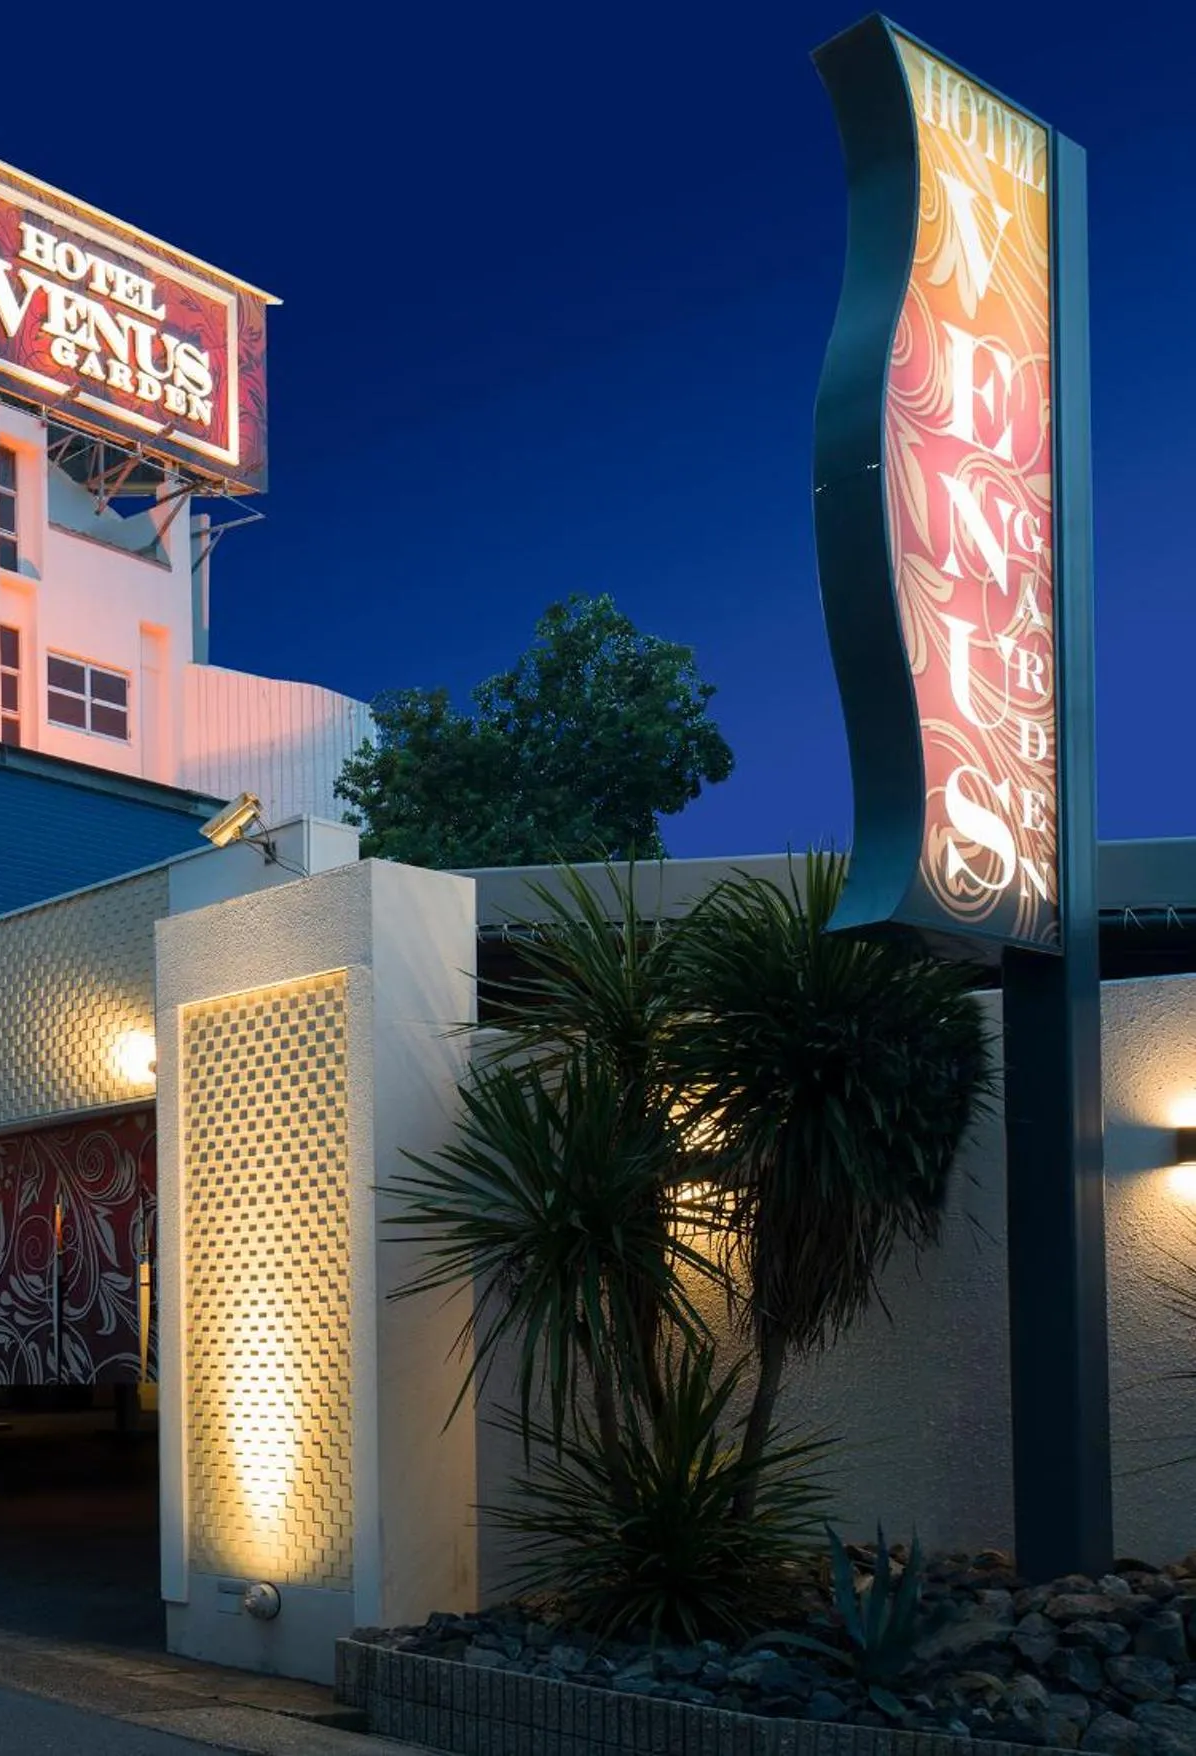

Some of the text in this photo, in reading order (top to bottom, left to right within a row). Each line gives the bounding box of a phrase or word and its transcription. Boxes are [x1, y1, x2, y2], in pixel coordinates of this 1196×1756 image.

[923, 56, 1046, 193] HOTEL
[19, 221, 165, 321] HOTEL
[51, 337, 212, 426] GARDEN
[936, 168, 1015, 890] VENUS
[1015, 508, 1050, 901] GARDEN
